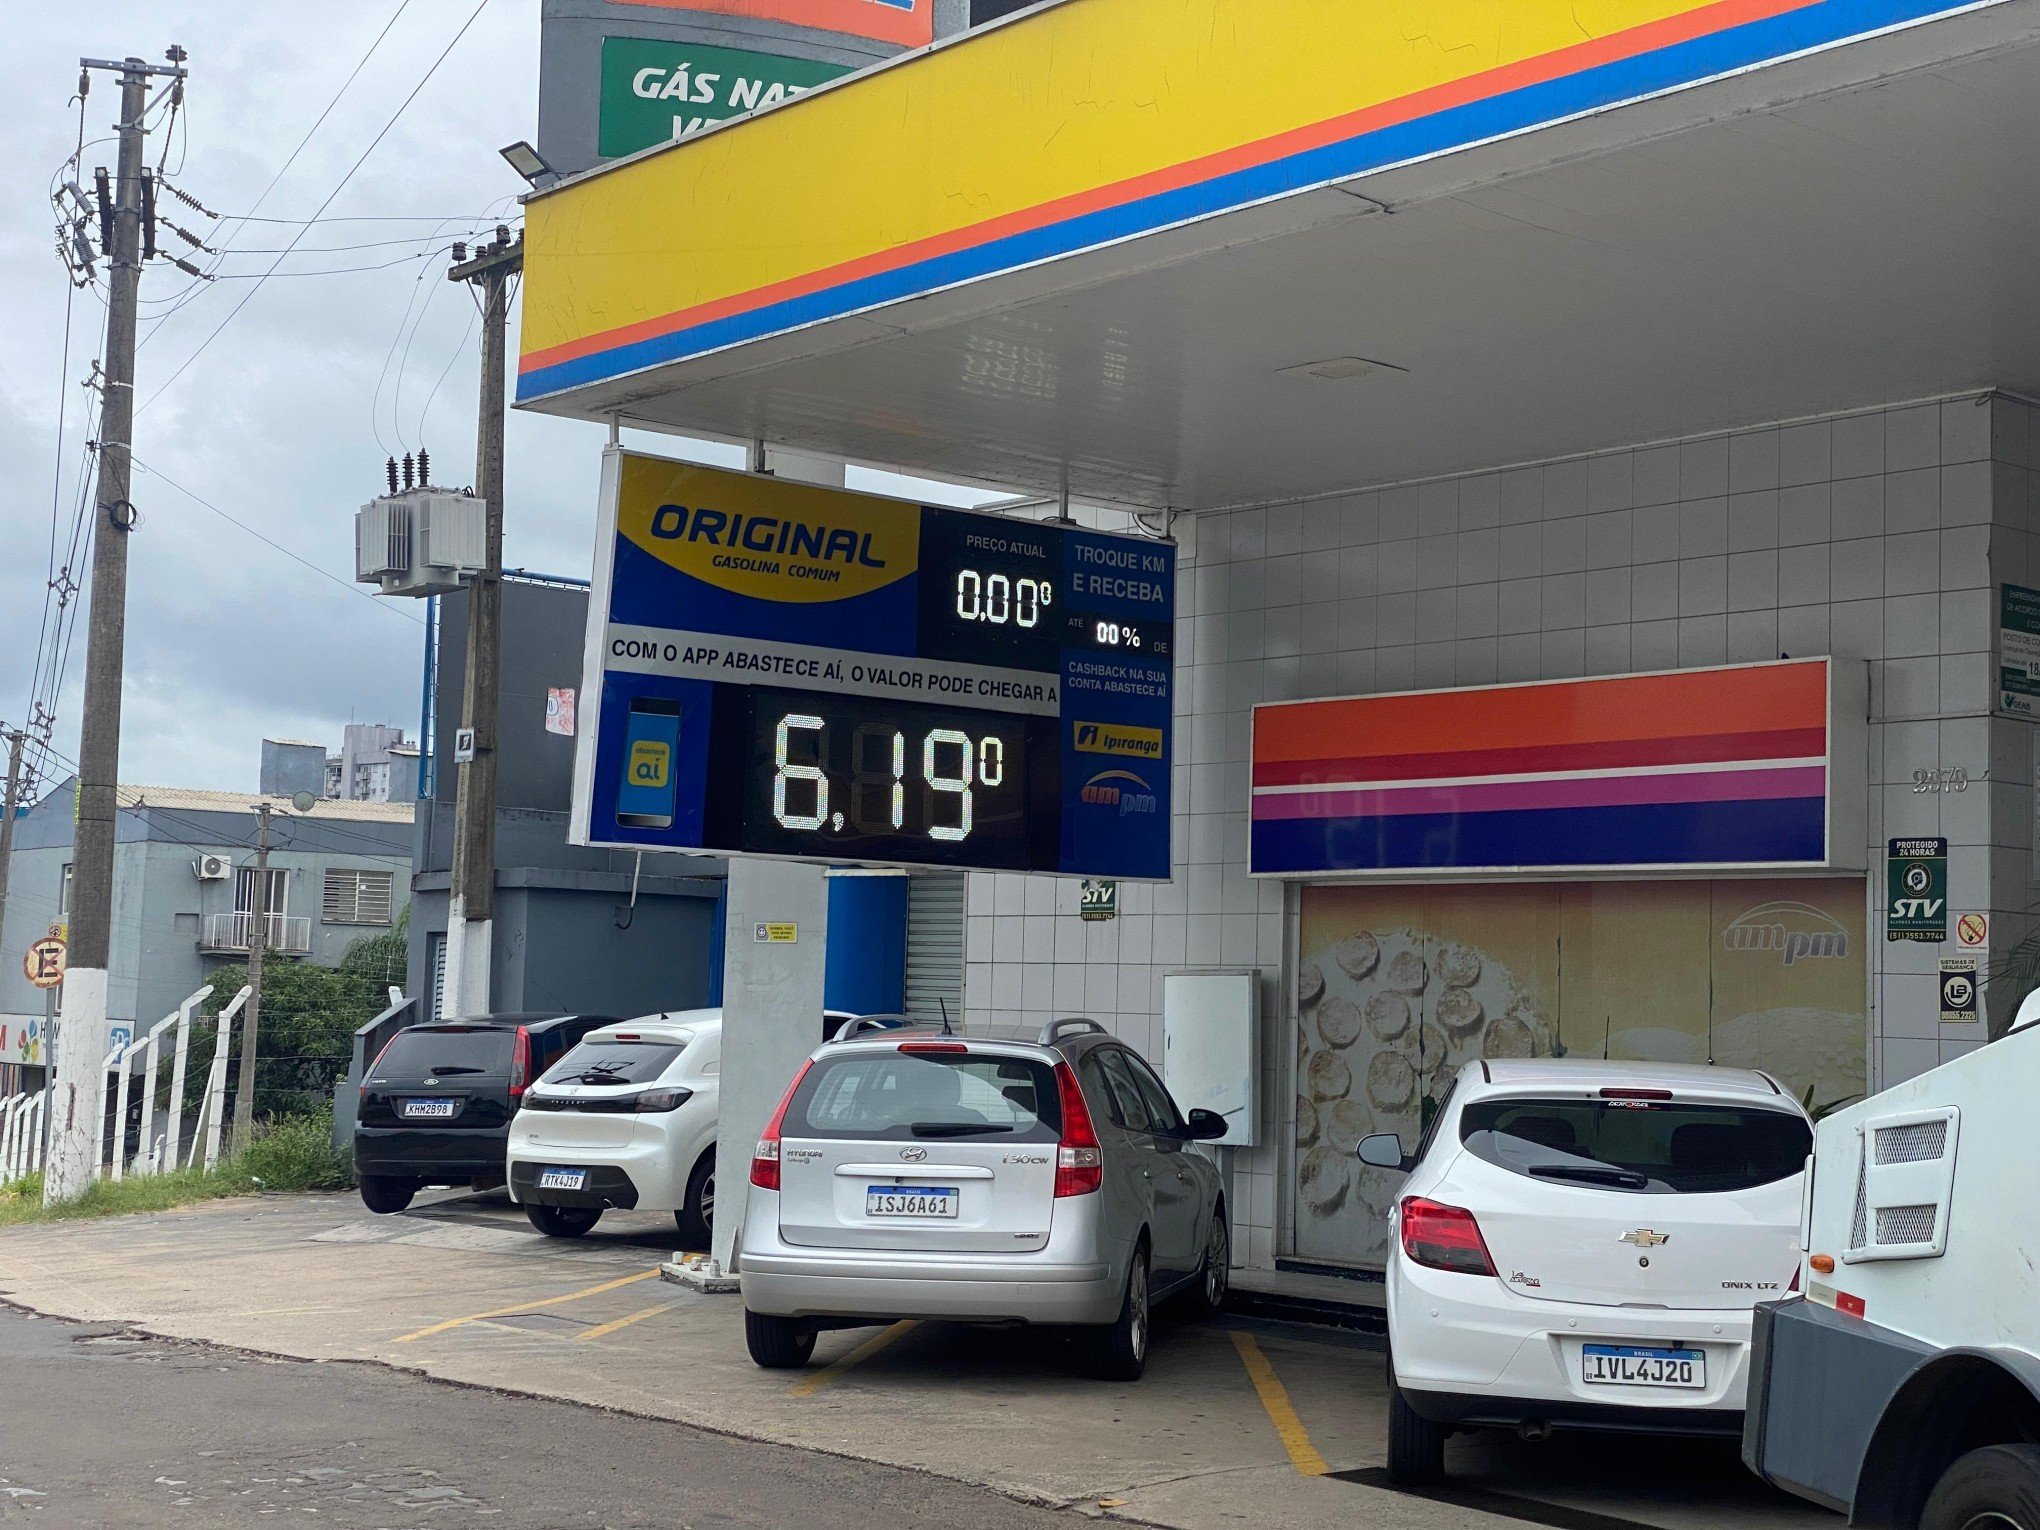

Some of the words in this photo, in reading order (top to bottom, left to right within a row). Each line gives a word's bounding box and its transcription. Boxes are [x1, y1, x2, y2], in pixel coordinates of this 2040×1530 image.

[632, 62, 720, 104] GÁS
[651, 504, 886, 568] ORIGINAL
[966, 535, 1007, 553] PREÇO
[1010, 541, 1046, 558] ATUAL
[712, 555, 780, 574] GASOLINA
[788, 564, 841, 582] COMUM
[1075, 545, 1138, 569] TROQUE
[1142, 556, 1166, 573] KM
[1073, 572, 1084, 592] E
[1089, 575, 1164, 603] RECEBA
[1154, 642, 1168, 653] DE
[611, 639, 658, 659] COM
[663, 644, 678, 662] O
[682, 647, 719, 666] APP
[722, 652, 820, 677] ABASTECE
[823, 659, 844, 683] AÍ,
[851, 666, 864, 682] O
[867, 667, 923, 689] VALOR
[928, 674, 974, 694] PODE
[978, 680, 1043, 701] CHEGAR
[1047, 687, 1058, 702] A
[1069, 661, 1127, 678] CASHBACK
[1130, 668, 1145, 681] NA
[1147, 670, 1167, 683] SUA
[1069, 677, 1101, 690] CONTA
[1104, 681, 1155, 696] ABASTECE
[1157, 686, 1166, 697] AÍ
[1913, 767, 1969, 794] 2979
[1896, 841, 1938, 849] PROTEGIDO
[1899, 849, 1909, 857] 24
[1910, 848, 1936, 856] HORAS
[1082, 887, 1114, 903] STV
[1890, 898, 1943, 918] STV
[409, 1104, 448, 1115] KHM2B98
[544, 1174, 579, 1188] RTK4J19
[875, 1195, 947, 1214] ISJ6A61
[1721, 1281, 1753, 1290] ONIX
[1757, 1281, 1779, 1290] LTZ
[1593, 1356, 1692, 1383] IVL4J20
